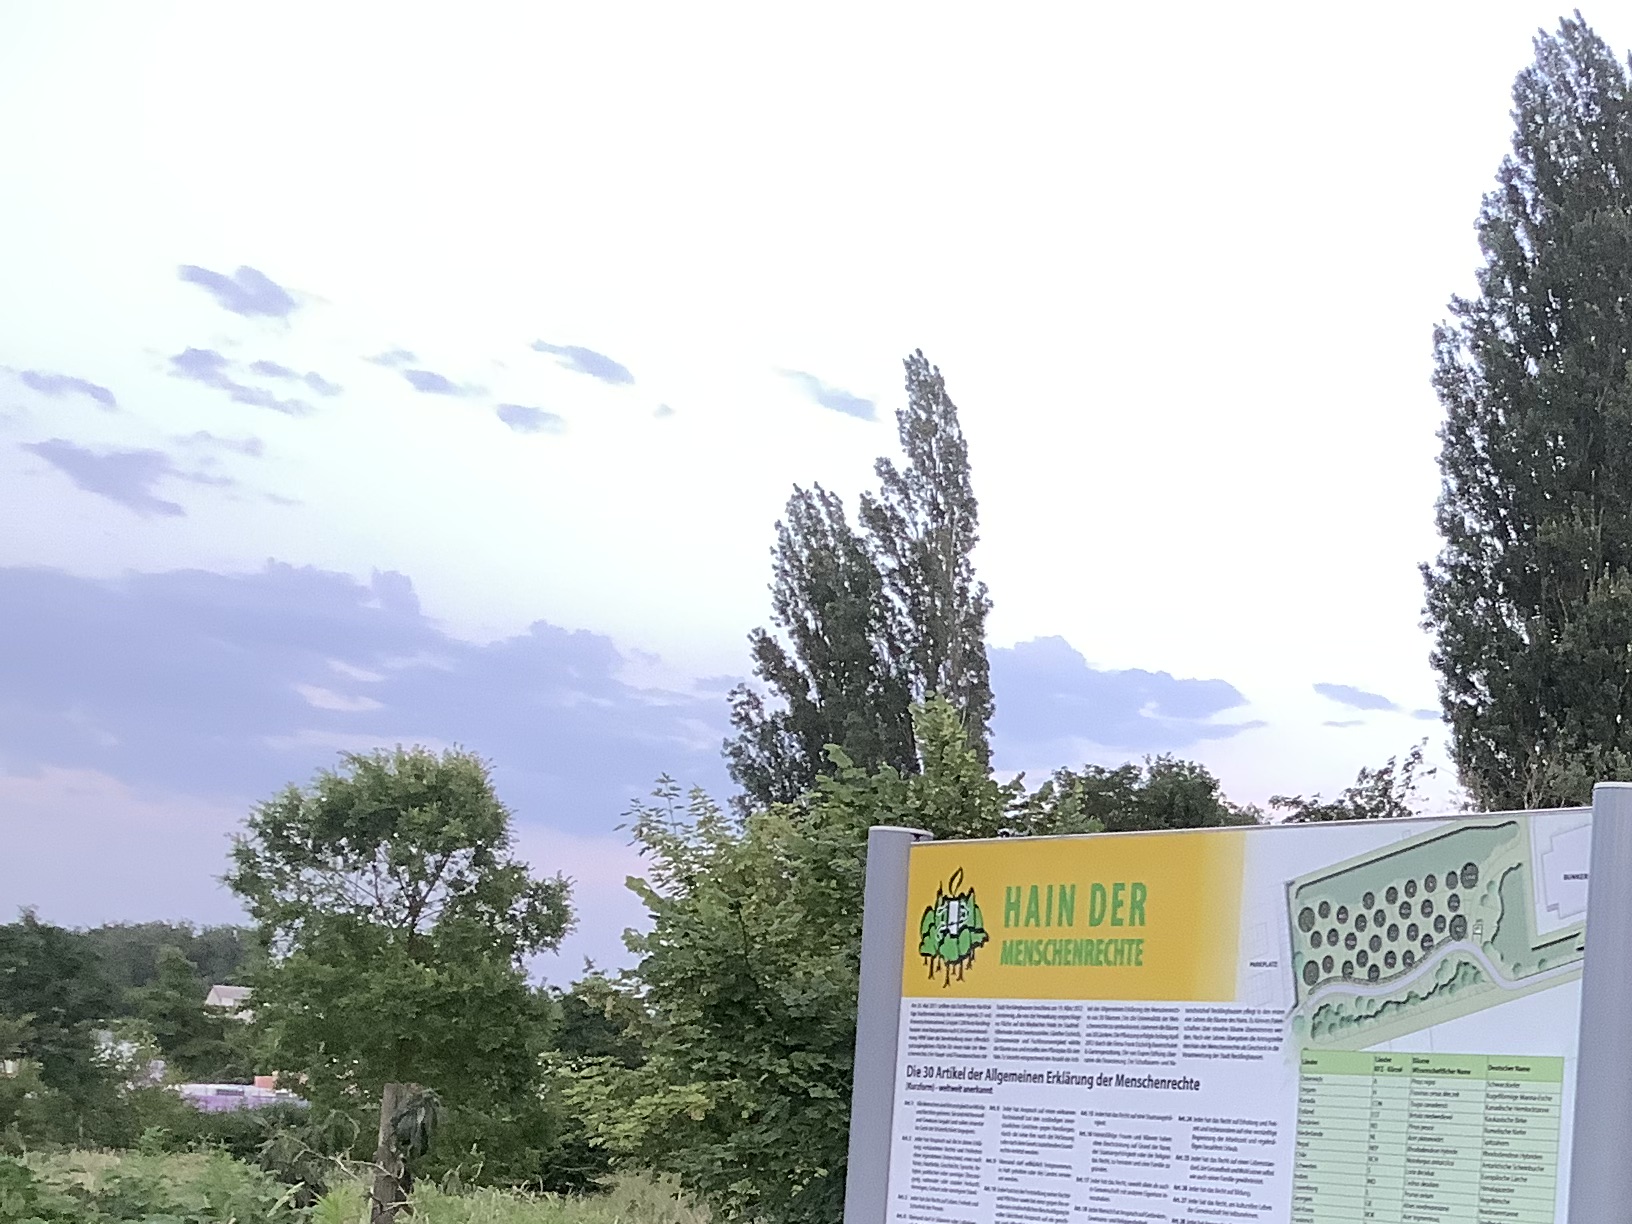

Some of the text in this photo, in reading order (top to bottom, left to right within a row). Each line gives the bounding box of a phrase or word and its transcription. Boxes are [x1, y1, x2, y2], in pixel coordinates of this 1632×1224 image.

[1004, 882, 1147, 928] HAIN DER
[1000, 938, 1144, 967] MENSCHENRECHTE
[905, 1064, 1200, 1090] Die 30 Artikel der Allgemeinen Erklärung der Menschenrechte
